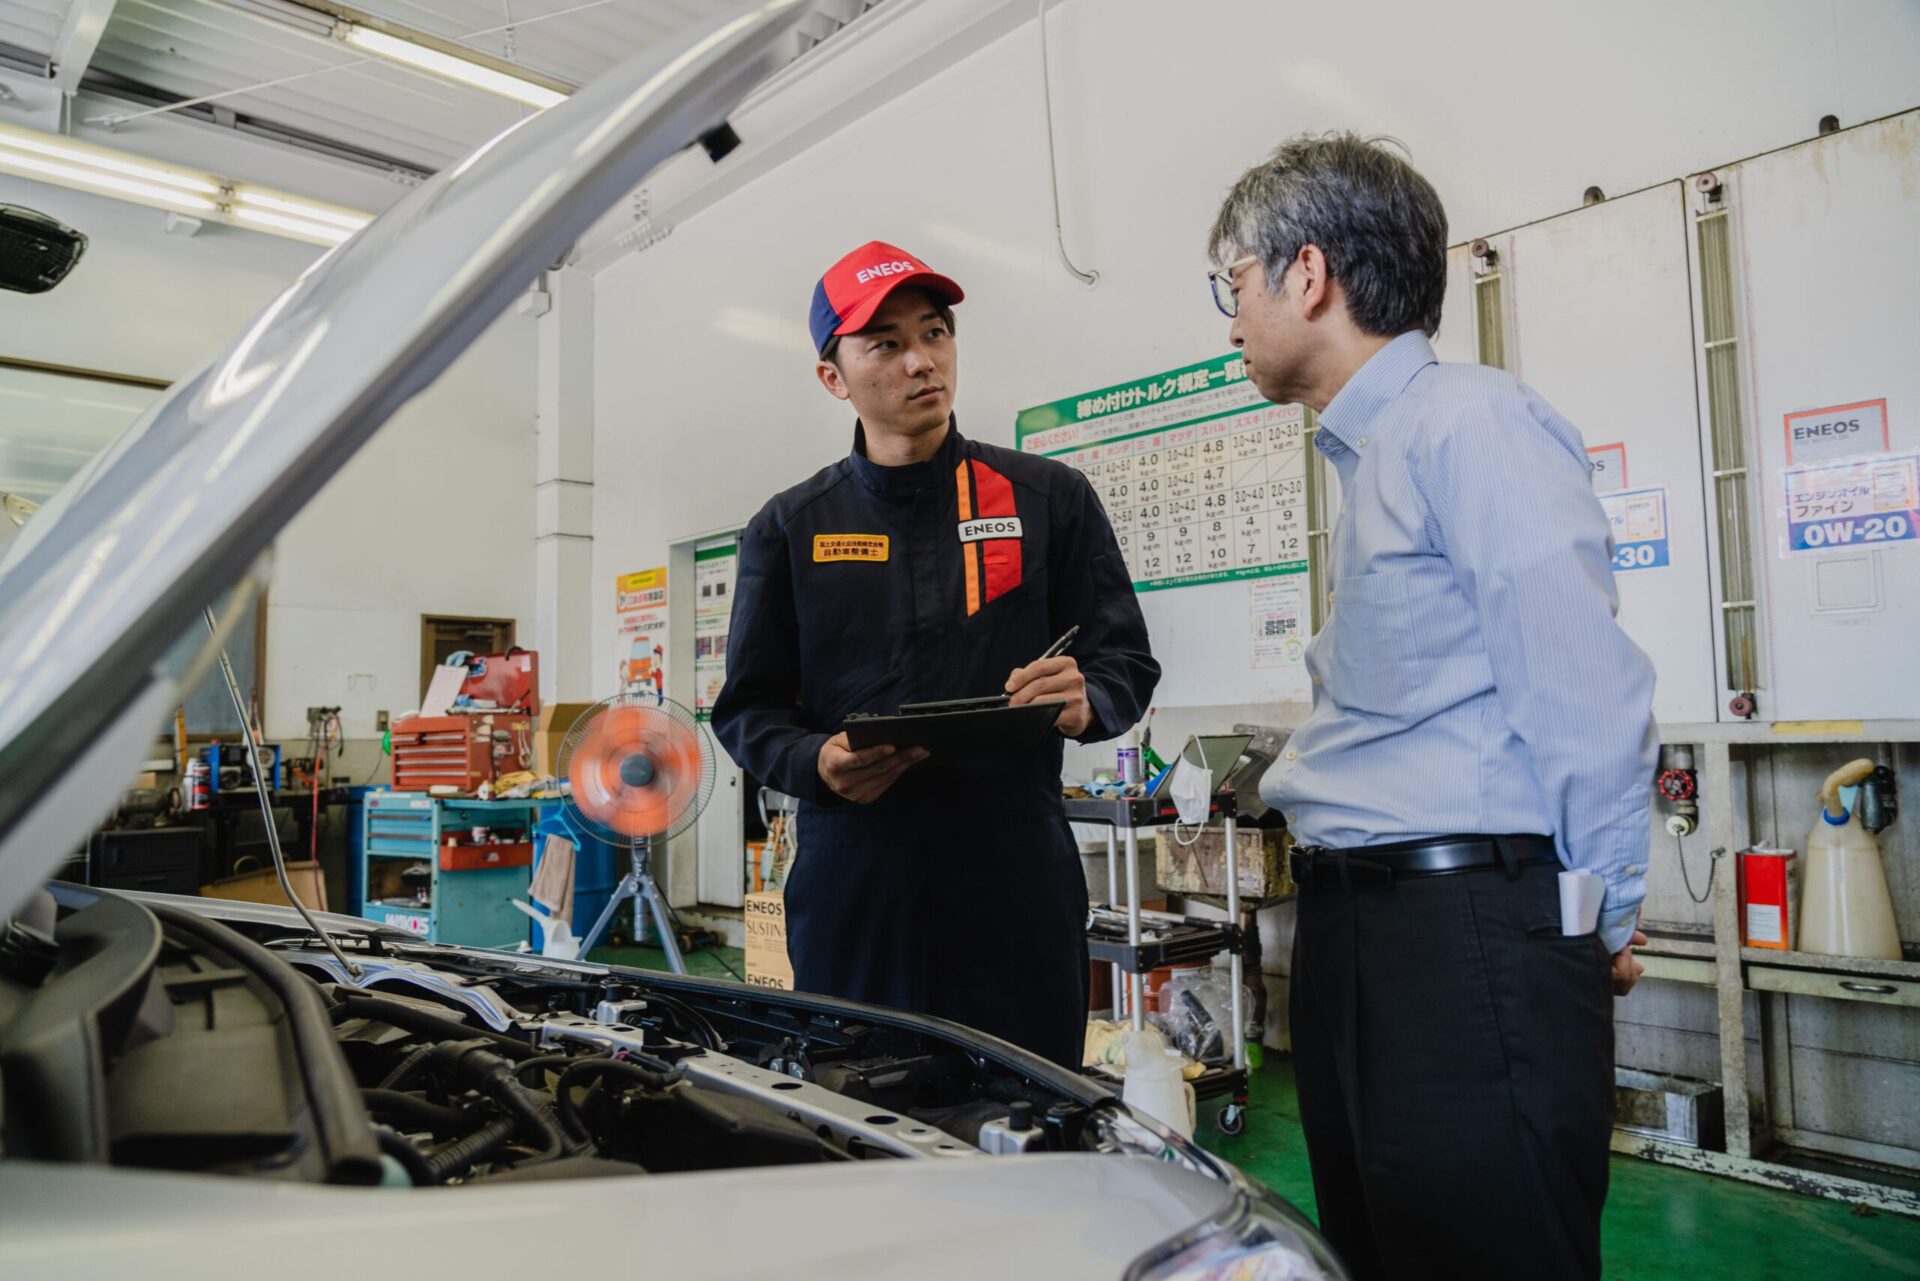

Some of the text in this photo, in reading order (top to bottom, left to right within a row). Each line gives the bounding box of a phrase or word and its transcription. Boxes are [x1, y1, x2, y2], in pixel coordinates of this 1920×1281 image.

[856, 261, 914, 284] ENEOS
[1794, 419, 1860, 440] ENEOS
[1139, 453, 1158, 467] 4.0
[1203, 440, 1224, 453] 4.8
[1109, 485, 1128, 498] 4.0
[1139, 479, 1159, 492] 4.0
[1203, 466, 1224, 480] 4.7
[1140, 505, 1160, 519] 4.0
[1205, 494, 1226, 507] 4.8
[1794, 487, 1870, 503] エンジンオイル
[1795, 501, 1854, 518] ファイン
[965, 522, 1016, 536] ENEOS
[1147, 532, 1155, 541] 9
[1179, 527, 1188, 537] 9
[1212, 521, 1221, 532] 8
[1246, 516, 1254, 525] 4
[1283, 510, 1292, 521] 9
[1803, 515, 1907, 546] 0W-20
[1145, 538, 1298, 568] 12 12 10 7 12
[746, 900, 783, 916] ENEOS
